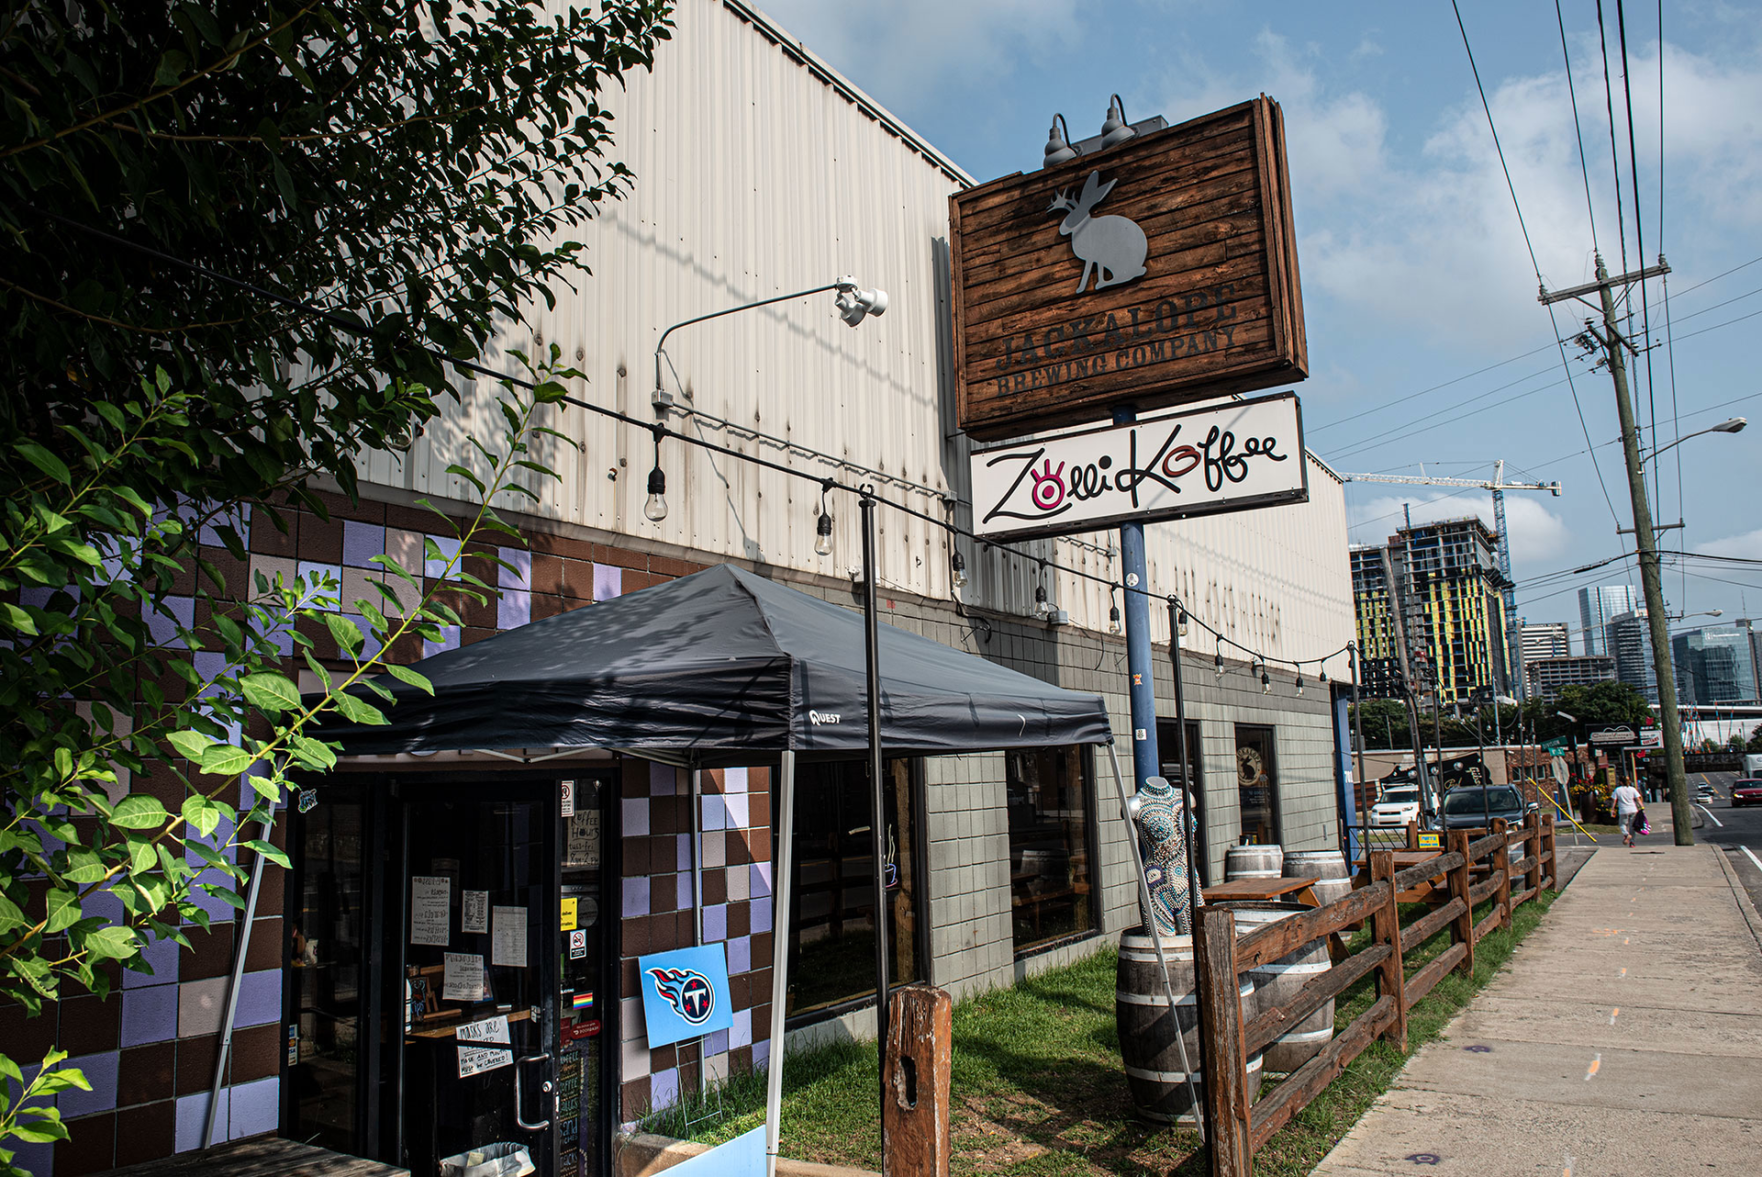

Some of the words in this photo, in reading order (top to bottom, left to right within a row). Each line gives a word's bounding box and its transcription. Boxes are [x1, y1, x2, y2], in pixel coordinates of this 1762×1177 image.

[995, 282, 1238, 372] JACKALOPE
[995, 355, 1108, 399] BREWING
[1115, 324, 1237, 370] COMPANY
[1115, 423, 1288, 509] Koffee
[808, 709, 842, 727] QUEST
